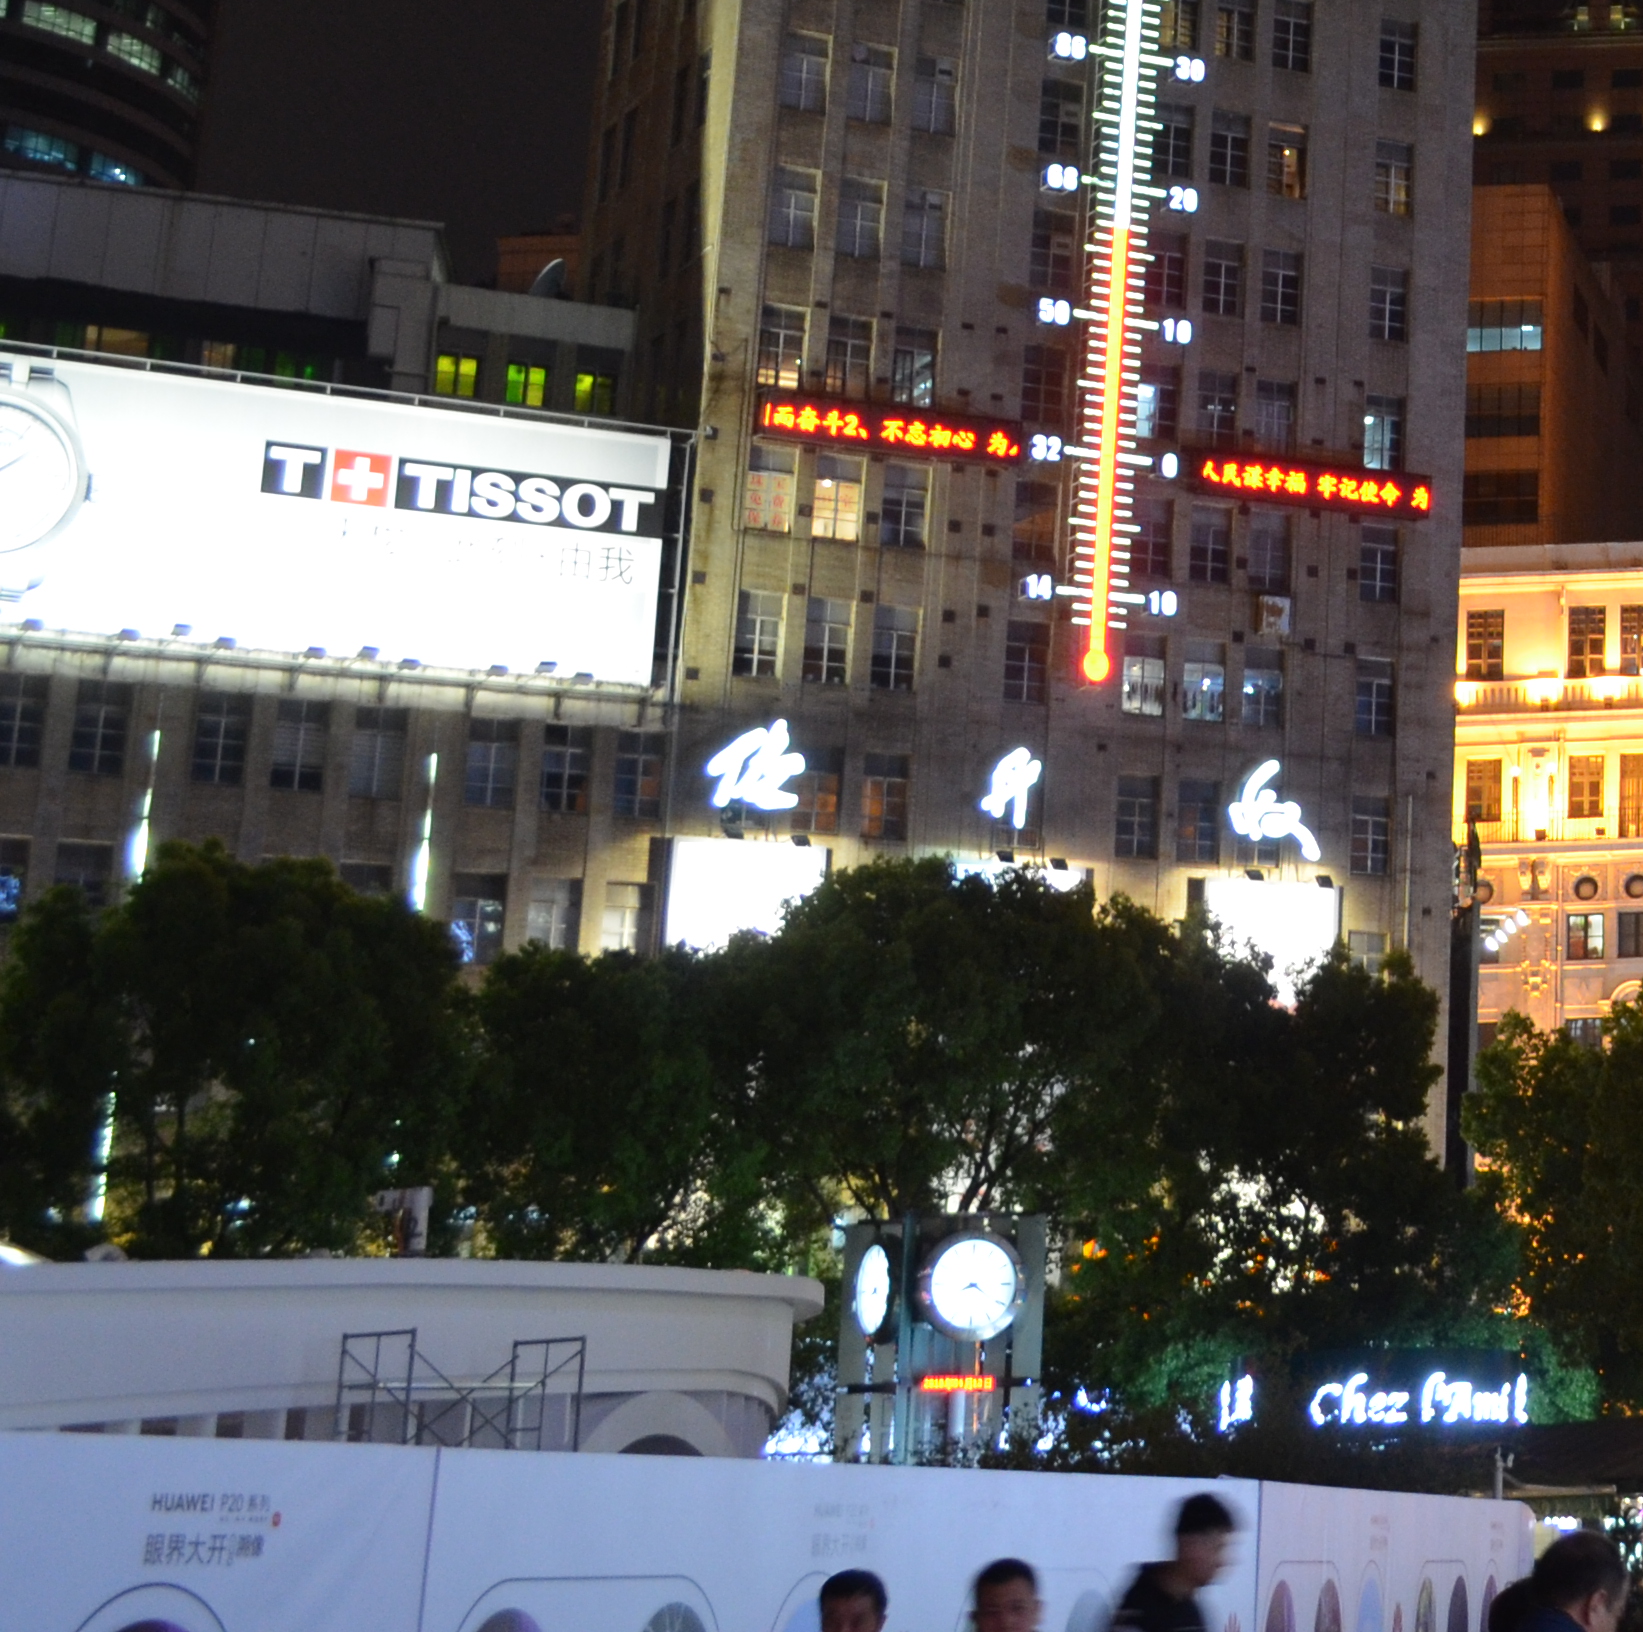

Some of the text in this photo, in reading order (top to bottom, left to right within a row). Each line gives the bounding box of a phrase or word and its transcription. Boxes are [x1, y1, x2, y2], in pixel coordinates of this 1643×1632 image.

[1176, 58, 1205, 84] 30
[1169, 188, 1199, 215] 20
[1038, 298, 1070, 326] 50
[1162, 319, 1192, 345] 10
[880, 418, 976, 451] 不忘初心
[1030, 434, 1062, 463] 32
[404, 462, 656, 533] TISSOT
[1203, 460, 1307, 495] 人民谋幸福
[1317, 473, 1401, 507] 牢记使命
[1025, 574, 1053, 600] 14
[1310, 1372, 1410, 1425] Chez
[151, 1493, 215, 1513] HUAWEI
[219, 1493, 245, 1513] P20
